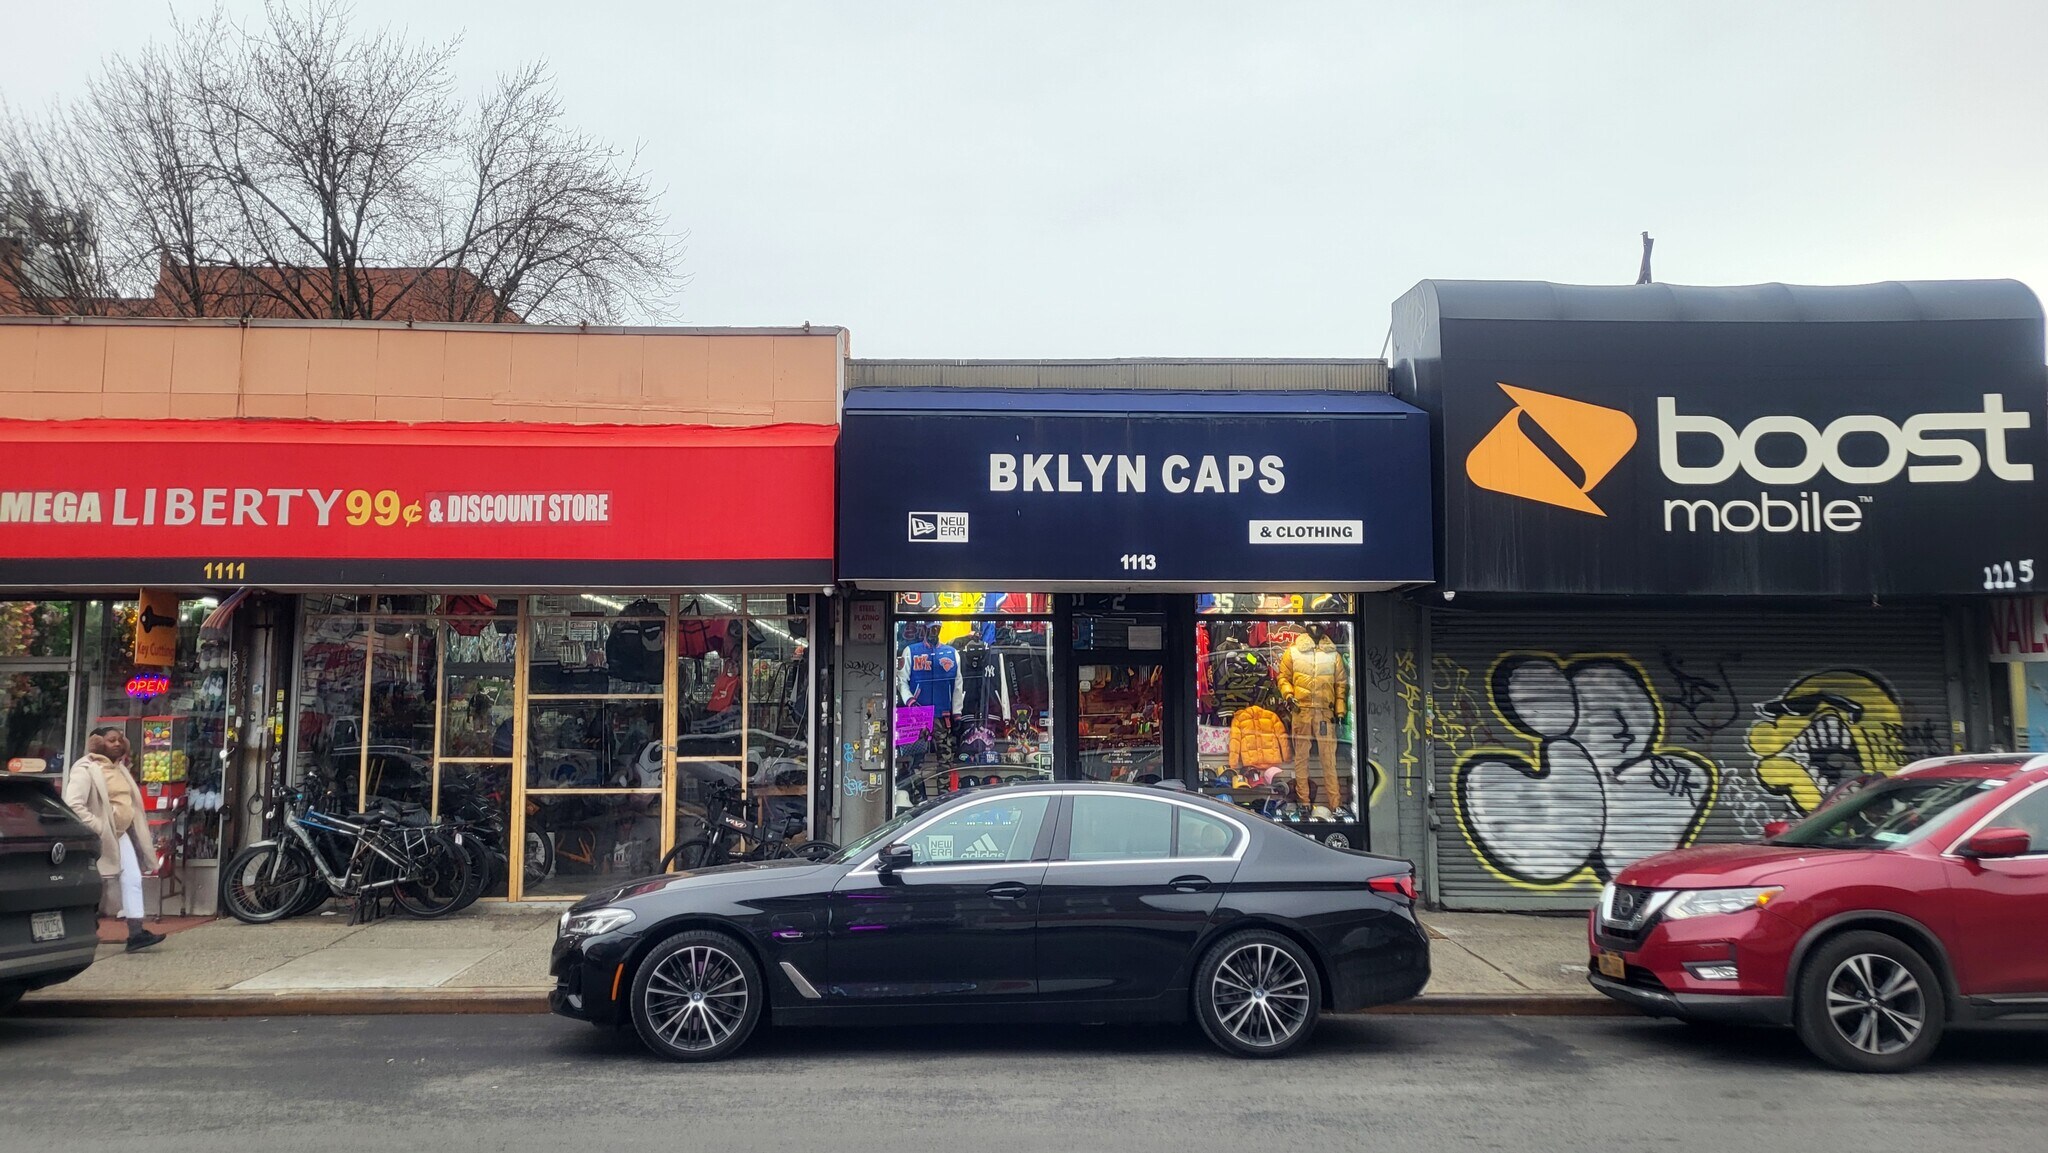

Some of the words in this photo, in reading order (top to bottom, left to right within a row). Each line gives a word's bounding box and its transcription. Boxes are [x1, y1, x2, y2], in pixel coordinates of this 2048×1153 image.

[1657, 393, 2035, 485] boost
[990, 454, 1146, 492] BKLYN
[1162, 455, 1286, 494] CAPS
[0, 491, 102, 523] MEGA
[112, 488, 344, 526] LIBERTY
[429, 499, 444, 522] &
[448, 494, 545, 522] DISCOUNT
[549, 494, 609, 521] STORE
[1664, 492, 1863, 533] mobile
[940, 516, 966, 526] NEW
[940, 527, 966, 537] ERA
[1260, 526, 1272, 538] &
[1276, 526, 1353, 538] CLOTHING
[204, 562, 245, 579] 1111
[1120, 555, 1157, 570] 1113
[1983, 559, 2034, 589] 1115
[1989, 598, 2048, 654] NAIL
[127, 680, 168, 693] OPEN
[930, 840, 953, 848] NEW
[930, 849, 953, 857] ERA
